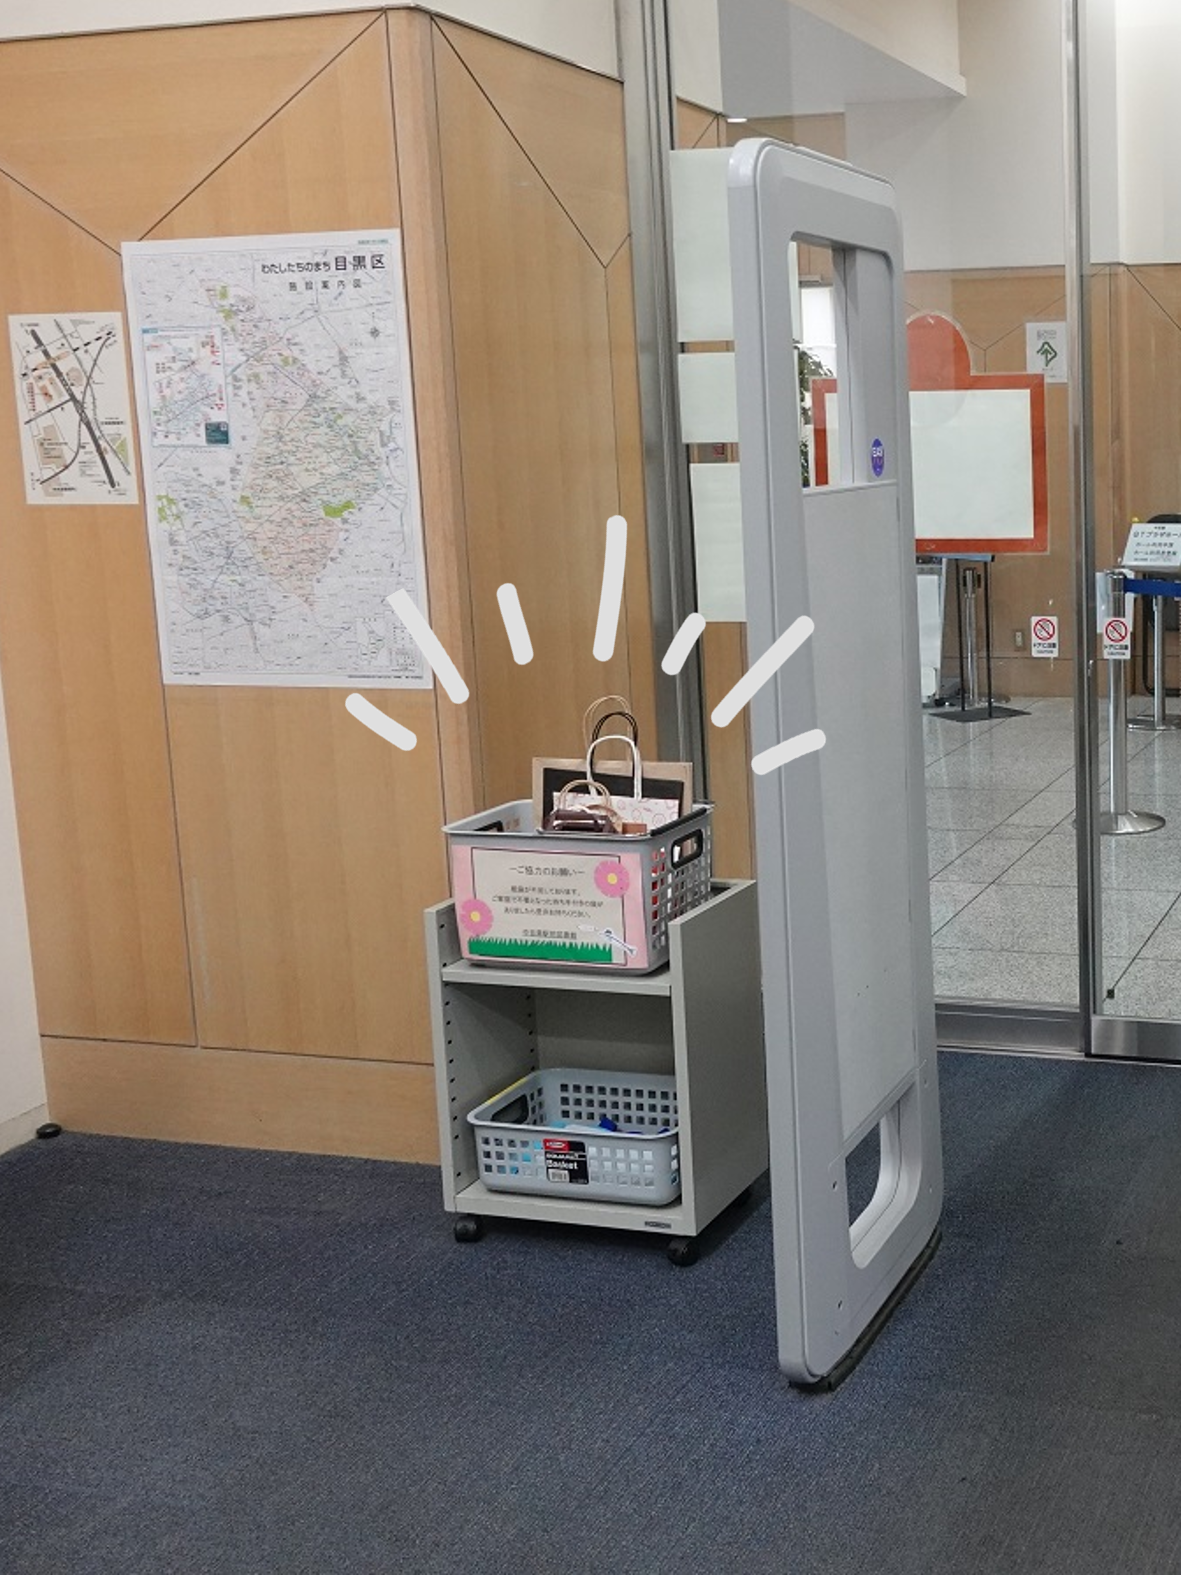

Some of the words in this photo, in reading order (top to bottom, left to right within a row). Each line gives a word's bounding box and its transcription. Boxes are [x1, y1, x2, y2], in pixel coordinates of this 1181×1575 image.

[261, 262, 331, 274] わたしたちのまち
[334, 253, 385, 271] 目黒区
